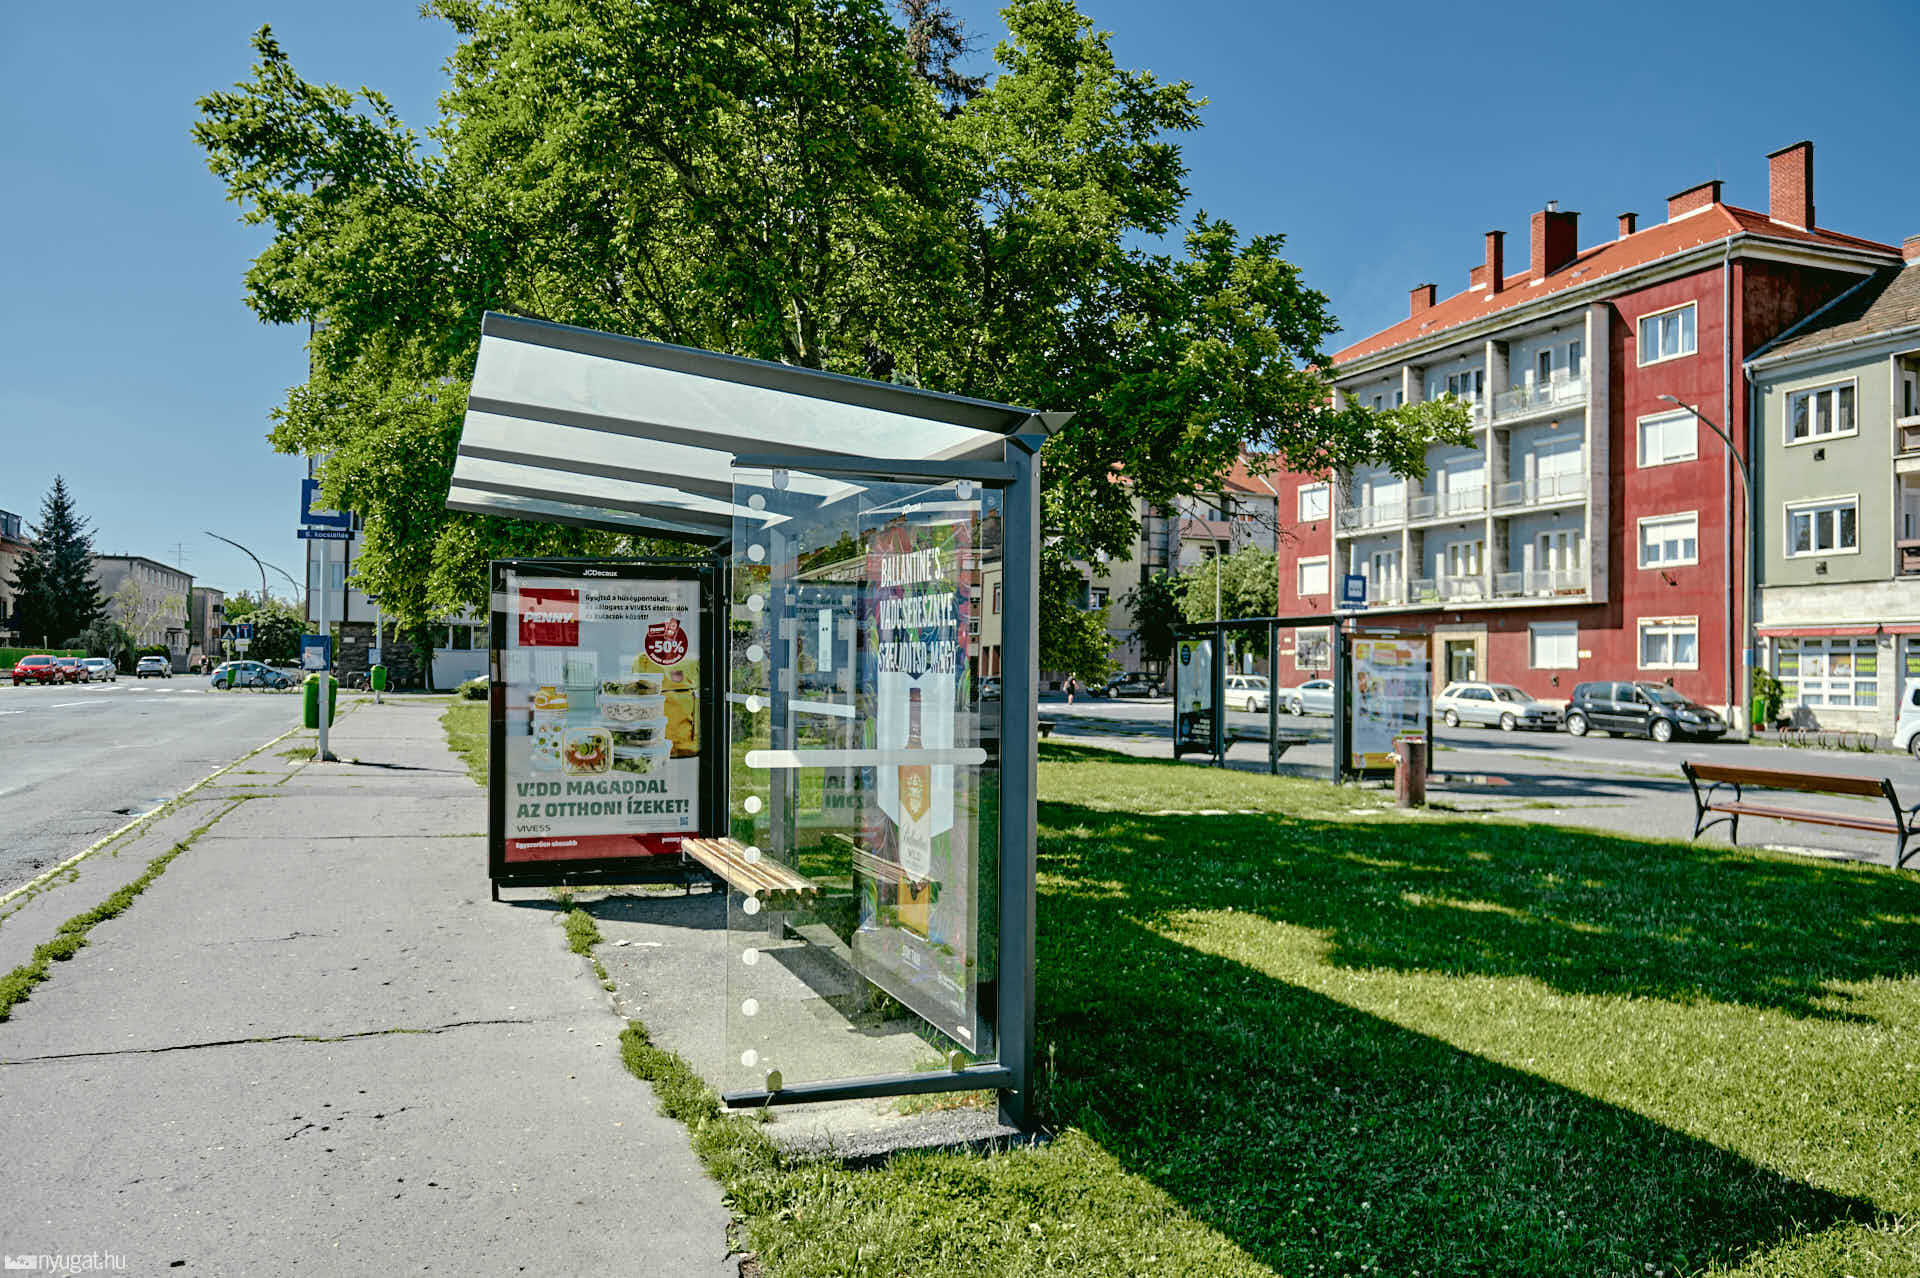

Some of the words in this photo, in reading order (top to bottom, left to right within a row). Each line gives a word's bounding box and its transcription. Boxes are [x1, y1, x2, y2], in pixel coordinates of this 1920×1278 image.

[582, 569, 618, 577] JCDecaux
[648, 640, 684, 654] -50%
[566, 780, 668, 796] MAGADDAL
[517, 803, 541, 818] AZ
[545, 801, 622, 817] OTTHONI
[627, 797, 689, 815] ÍZEKET!
[517, 824, 552, 833] VIVESS
